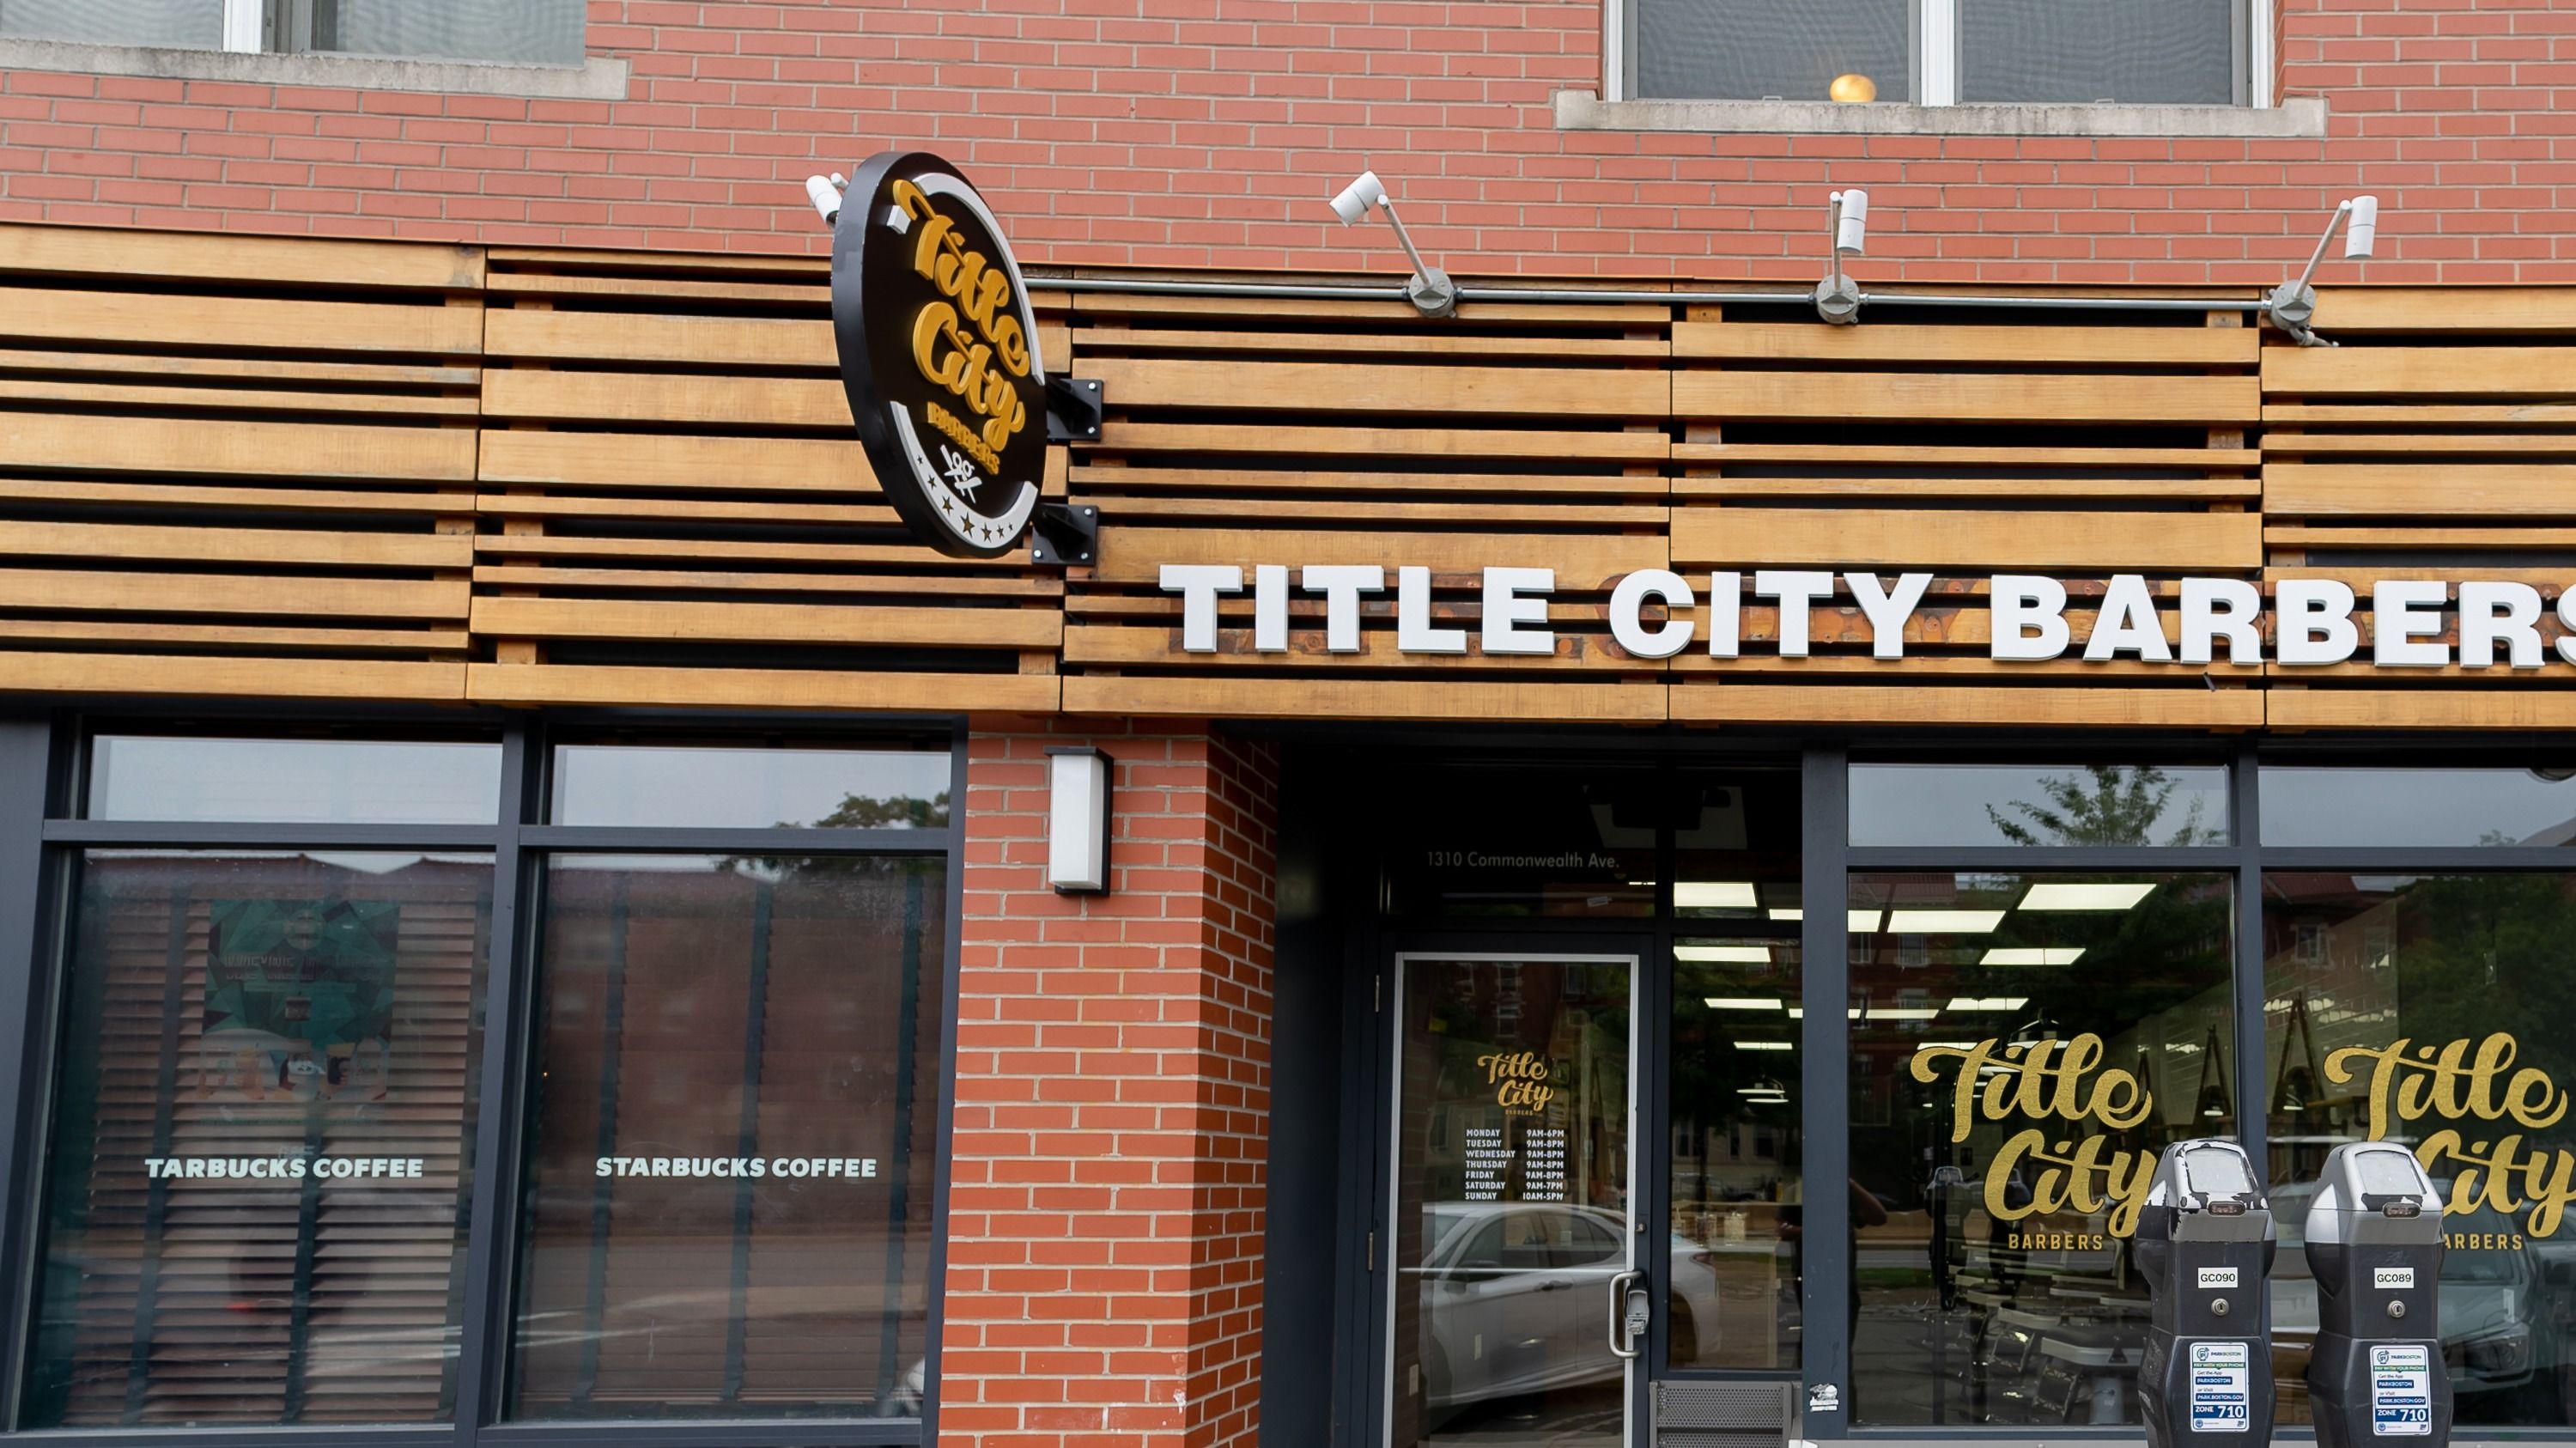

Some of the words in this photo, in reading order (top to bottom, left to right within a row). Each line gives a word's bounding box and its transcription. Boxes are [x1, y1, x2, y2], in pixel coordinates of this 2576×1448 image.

[892, 179, 1030, 376] Title
[913, 301, 1025, 452] City
[927, 401, 1000, 475] BARBERS
[1159, 564, 1555, 655] TITLE
[1608, 569, 1934, 660] CITY
[1990, 575, 2576, 669] BARBER
[1427, 852, 1462, 867] 1310
[1467, 852, 1583, 867] Commonwealth
[1588, 853, 1620, 867] Ave.
[1477, 1051, 1548, 1085] Title
[1498, 1080, 1554, 1111] City
[1910, 1032, 2154, 1143] Title
[2324, 1032, 2567, 1142] Title
[1466, 1129, 1501, 1137] MONDAY
[1526, 1129, 1564, 1138] 9AM-6PM
[1526, 1150, 1564, 1159] 9AM-8PM
[145, 1158, 307, 1179] TARBUCKS
[312, 1158, 423, 1178] COFFEE
[596, 1156, 766, 1177] STARBUCKS
[771, 1157, 877, 1177] COFFEE
[1466, 1160, 1507, 1169] THURSDAY
[1526, 1160, 1564, 1169] 9AM-8PM
[1465, 1171, 1494, 1179] FRIDAY
[1525, 1171, 1564, 1179] 9AM-8PM
[1983, 1129, 2157, 1238] City
[1522, 1192, 1564, 1201] 10AM-5PM
[2008, 1233, 2104, 1251] BARBERS
[2445, 1233, 2523, 1250] ARBERS
[2200, 1273, 2236, 1283] GC090
[2377, 1273, 2412, 1283] GC089
[2217, 1406, 2244, 1418] 710
[2400, 1409, 2427, 1421] 710
